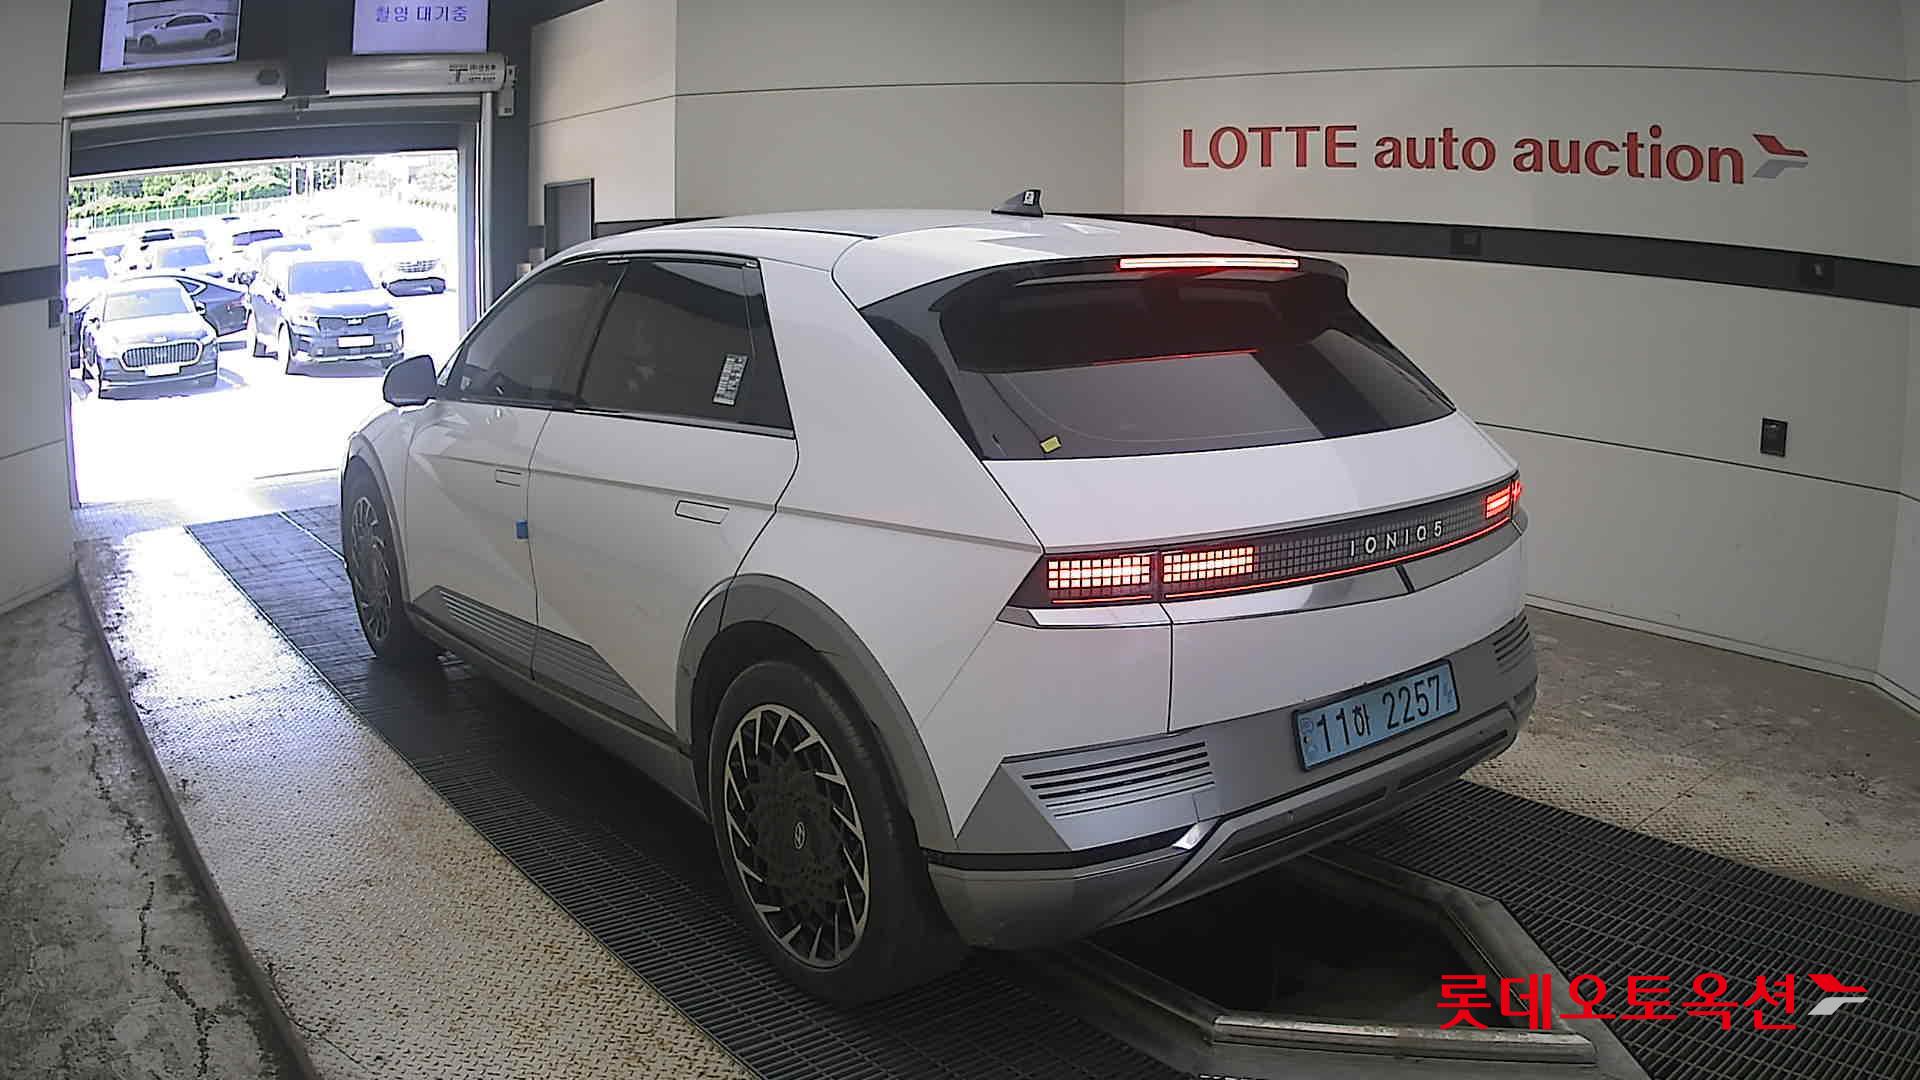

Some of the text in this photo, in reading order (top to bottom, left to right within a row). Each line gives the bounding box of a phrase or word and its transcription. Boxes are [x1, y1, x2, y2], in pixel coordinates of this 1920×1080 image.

[416, 5, 468, 22] 대기중
[1182, 124, 1744, 184] LOTTE auto auction
[1382, 674, 1440, 730] 2257
